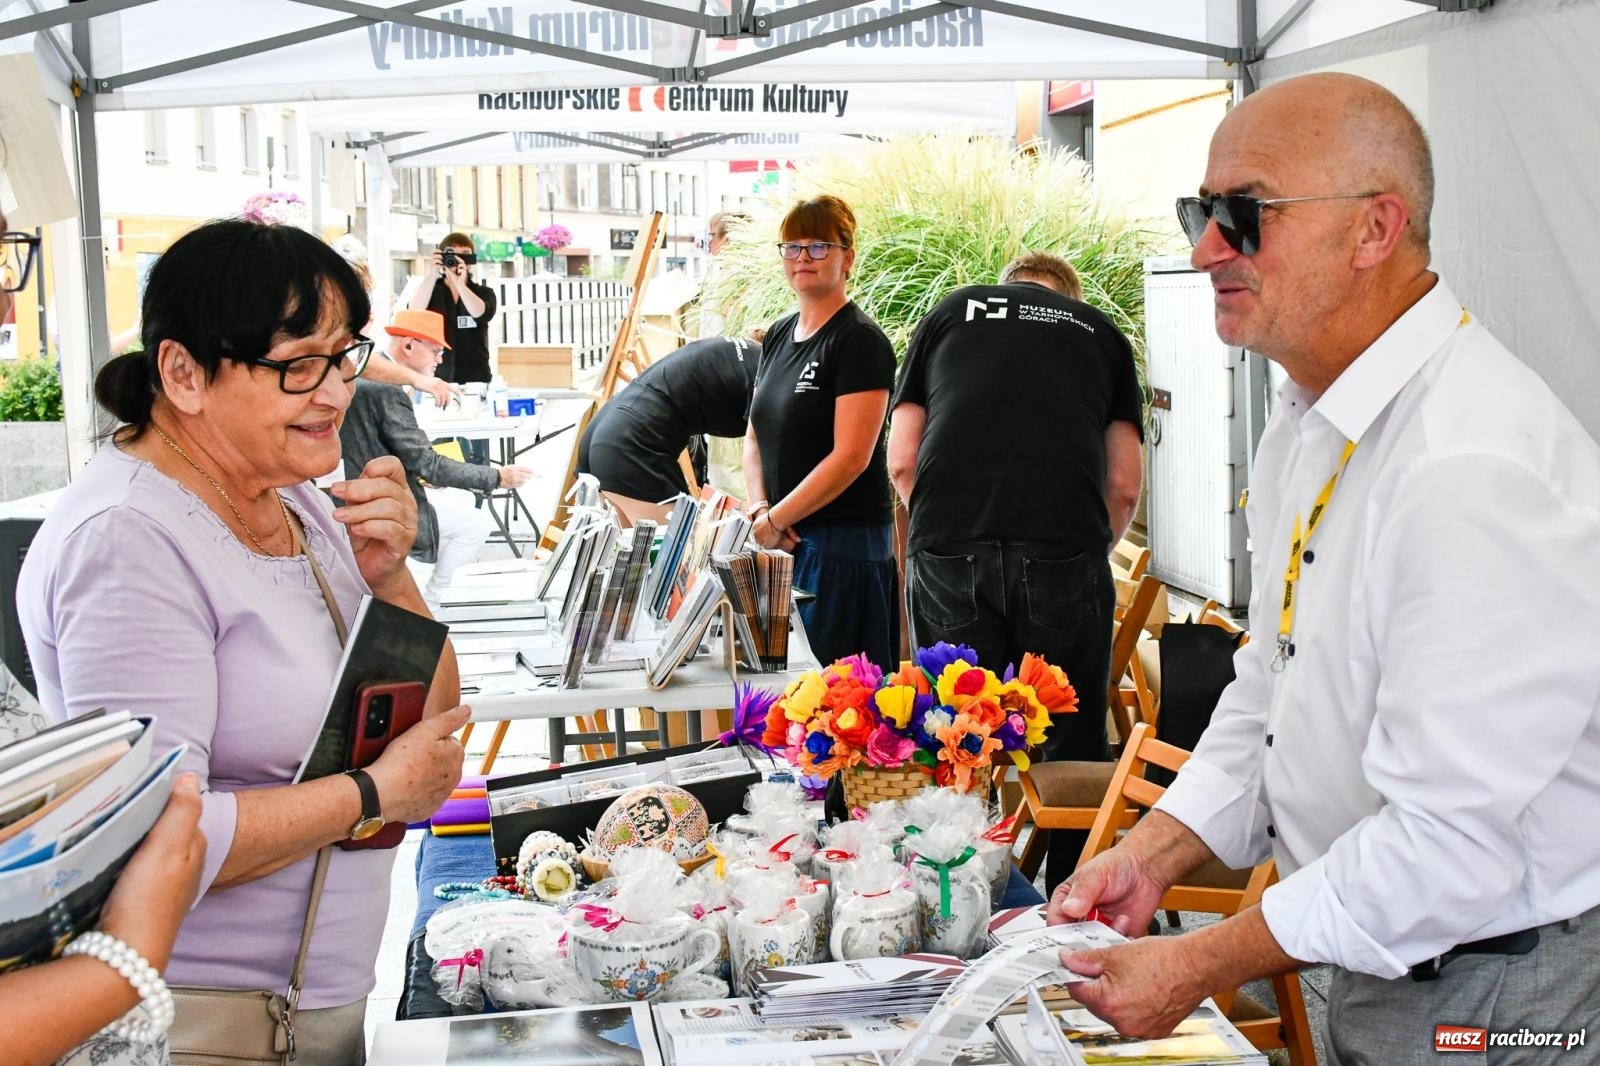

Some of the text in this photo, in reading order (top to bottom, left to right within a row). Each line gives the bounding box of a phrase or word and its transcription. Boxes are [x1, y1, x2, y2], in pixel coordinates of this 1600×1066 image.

[763, 83, 848, 117] Kultury
[1018, 313, 1058, 324] GÓRACH
[1019, 304, 1073, 318] MUZEUM
[1029, 311, 1095, 334] TARNOWSKICH
